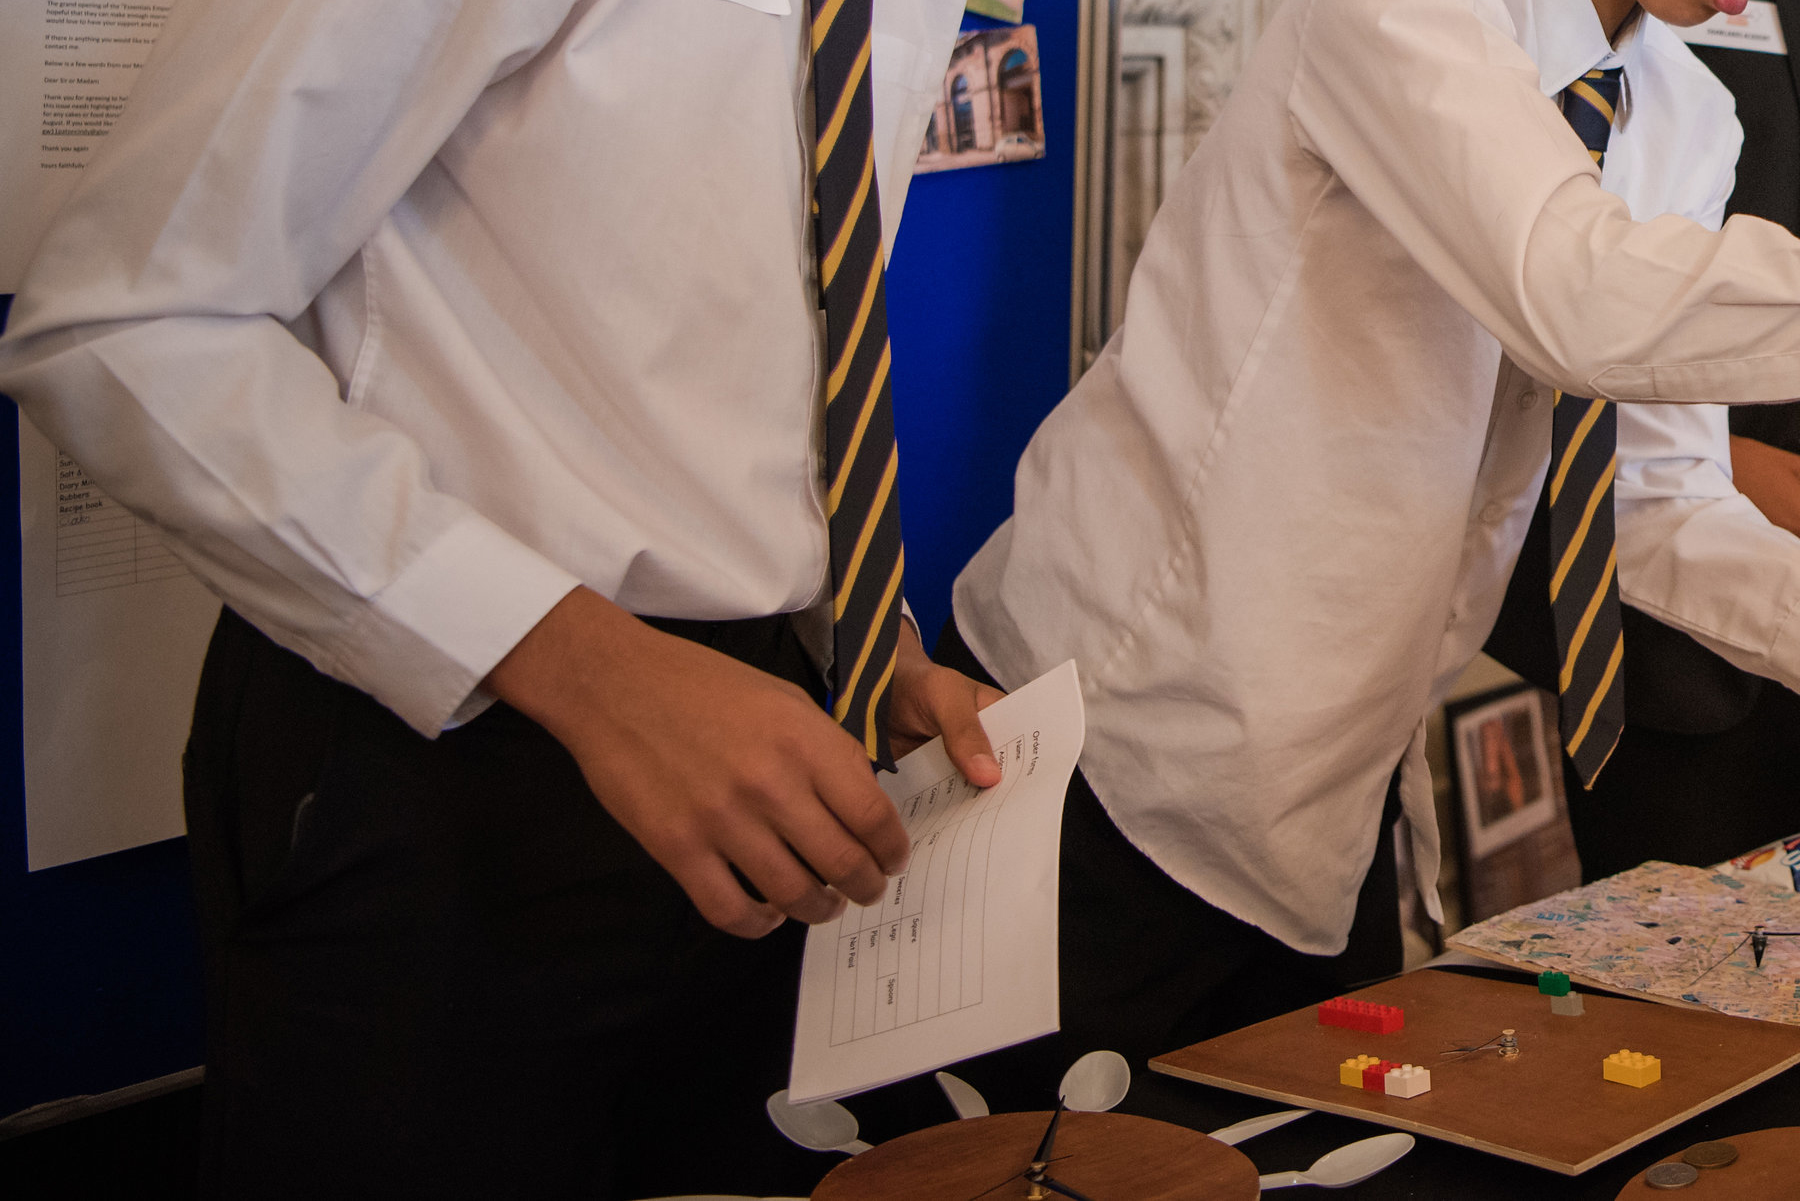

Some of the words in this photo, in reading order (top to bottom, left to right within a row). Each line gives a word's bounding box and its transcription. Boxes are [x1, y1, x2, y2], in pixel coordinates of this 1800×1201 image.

[59, 1, 76, 9] grand
[60, 492, 90, 501] Rubbers
[60, 504, 83, 513] Recipe
[86, 500, 103, 509] book
[1032, 730, 1041, 755] Order
[894, 876, 906, 905] Sweeties
[870, 929, 878, 948] Plain
[890, 923, 899, 942] Lego
[911, 917, 920, 943] Square
[849, 936, 857, 952] Not
[847, 952, 856, 969] Paid
[887, 978, 896, 1005] Spoons
